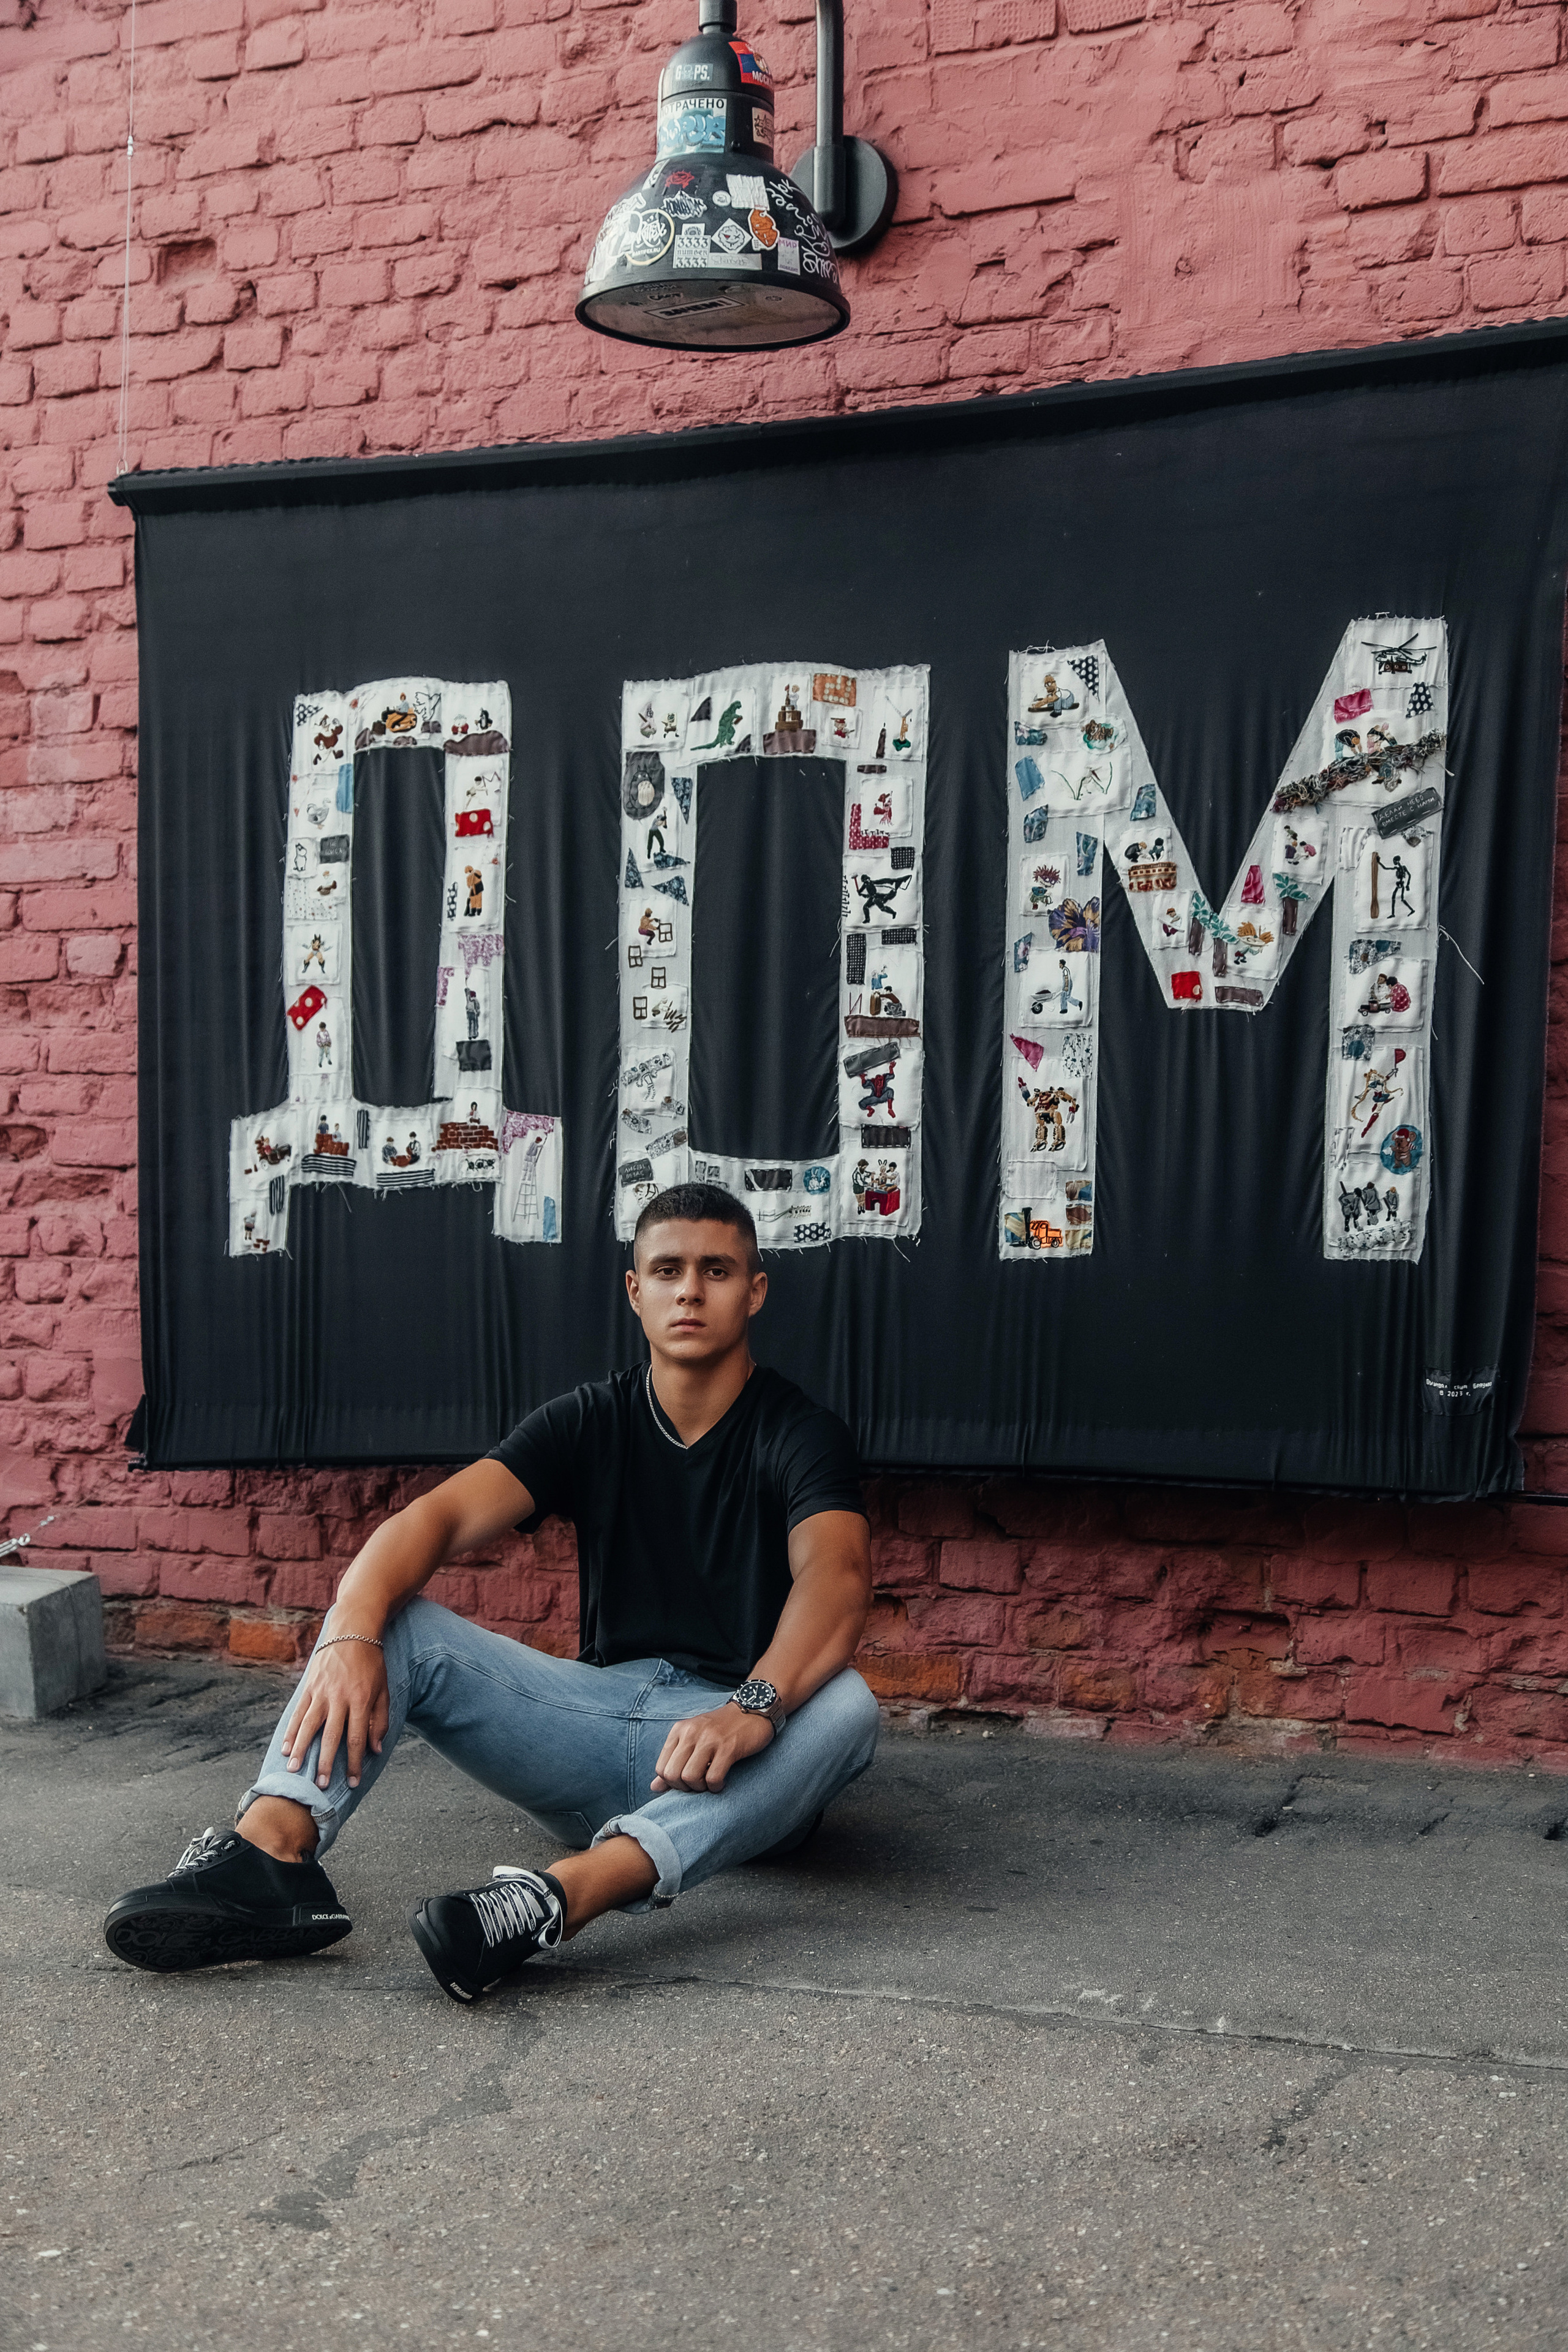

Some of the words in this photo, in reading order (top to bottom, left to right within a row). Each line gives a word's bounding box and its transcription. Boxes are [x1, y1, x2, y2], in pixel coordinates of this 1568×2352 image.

[660, 99, 724, 118] ПОТРАЧЕНО
[1382, 810, 1407, 827] ВМЕСТЕ
[1417, 797, 1435, 808] НАМИ
[1407, 794, 1424, 806] НЕБО
[228, 616, 1447, 1263] ДОМ
